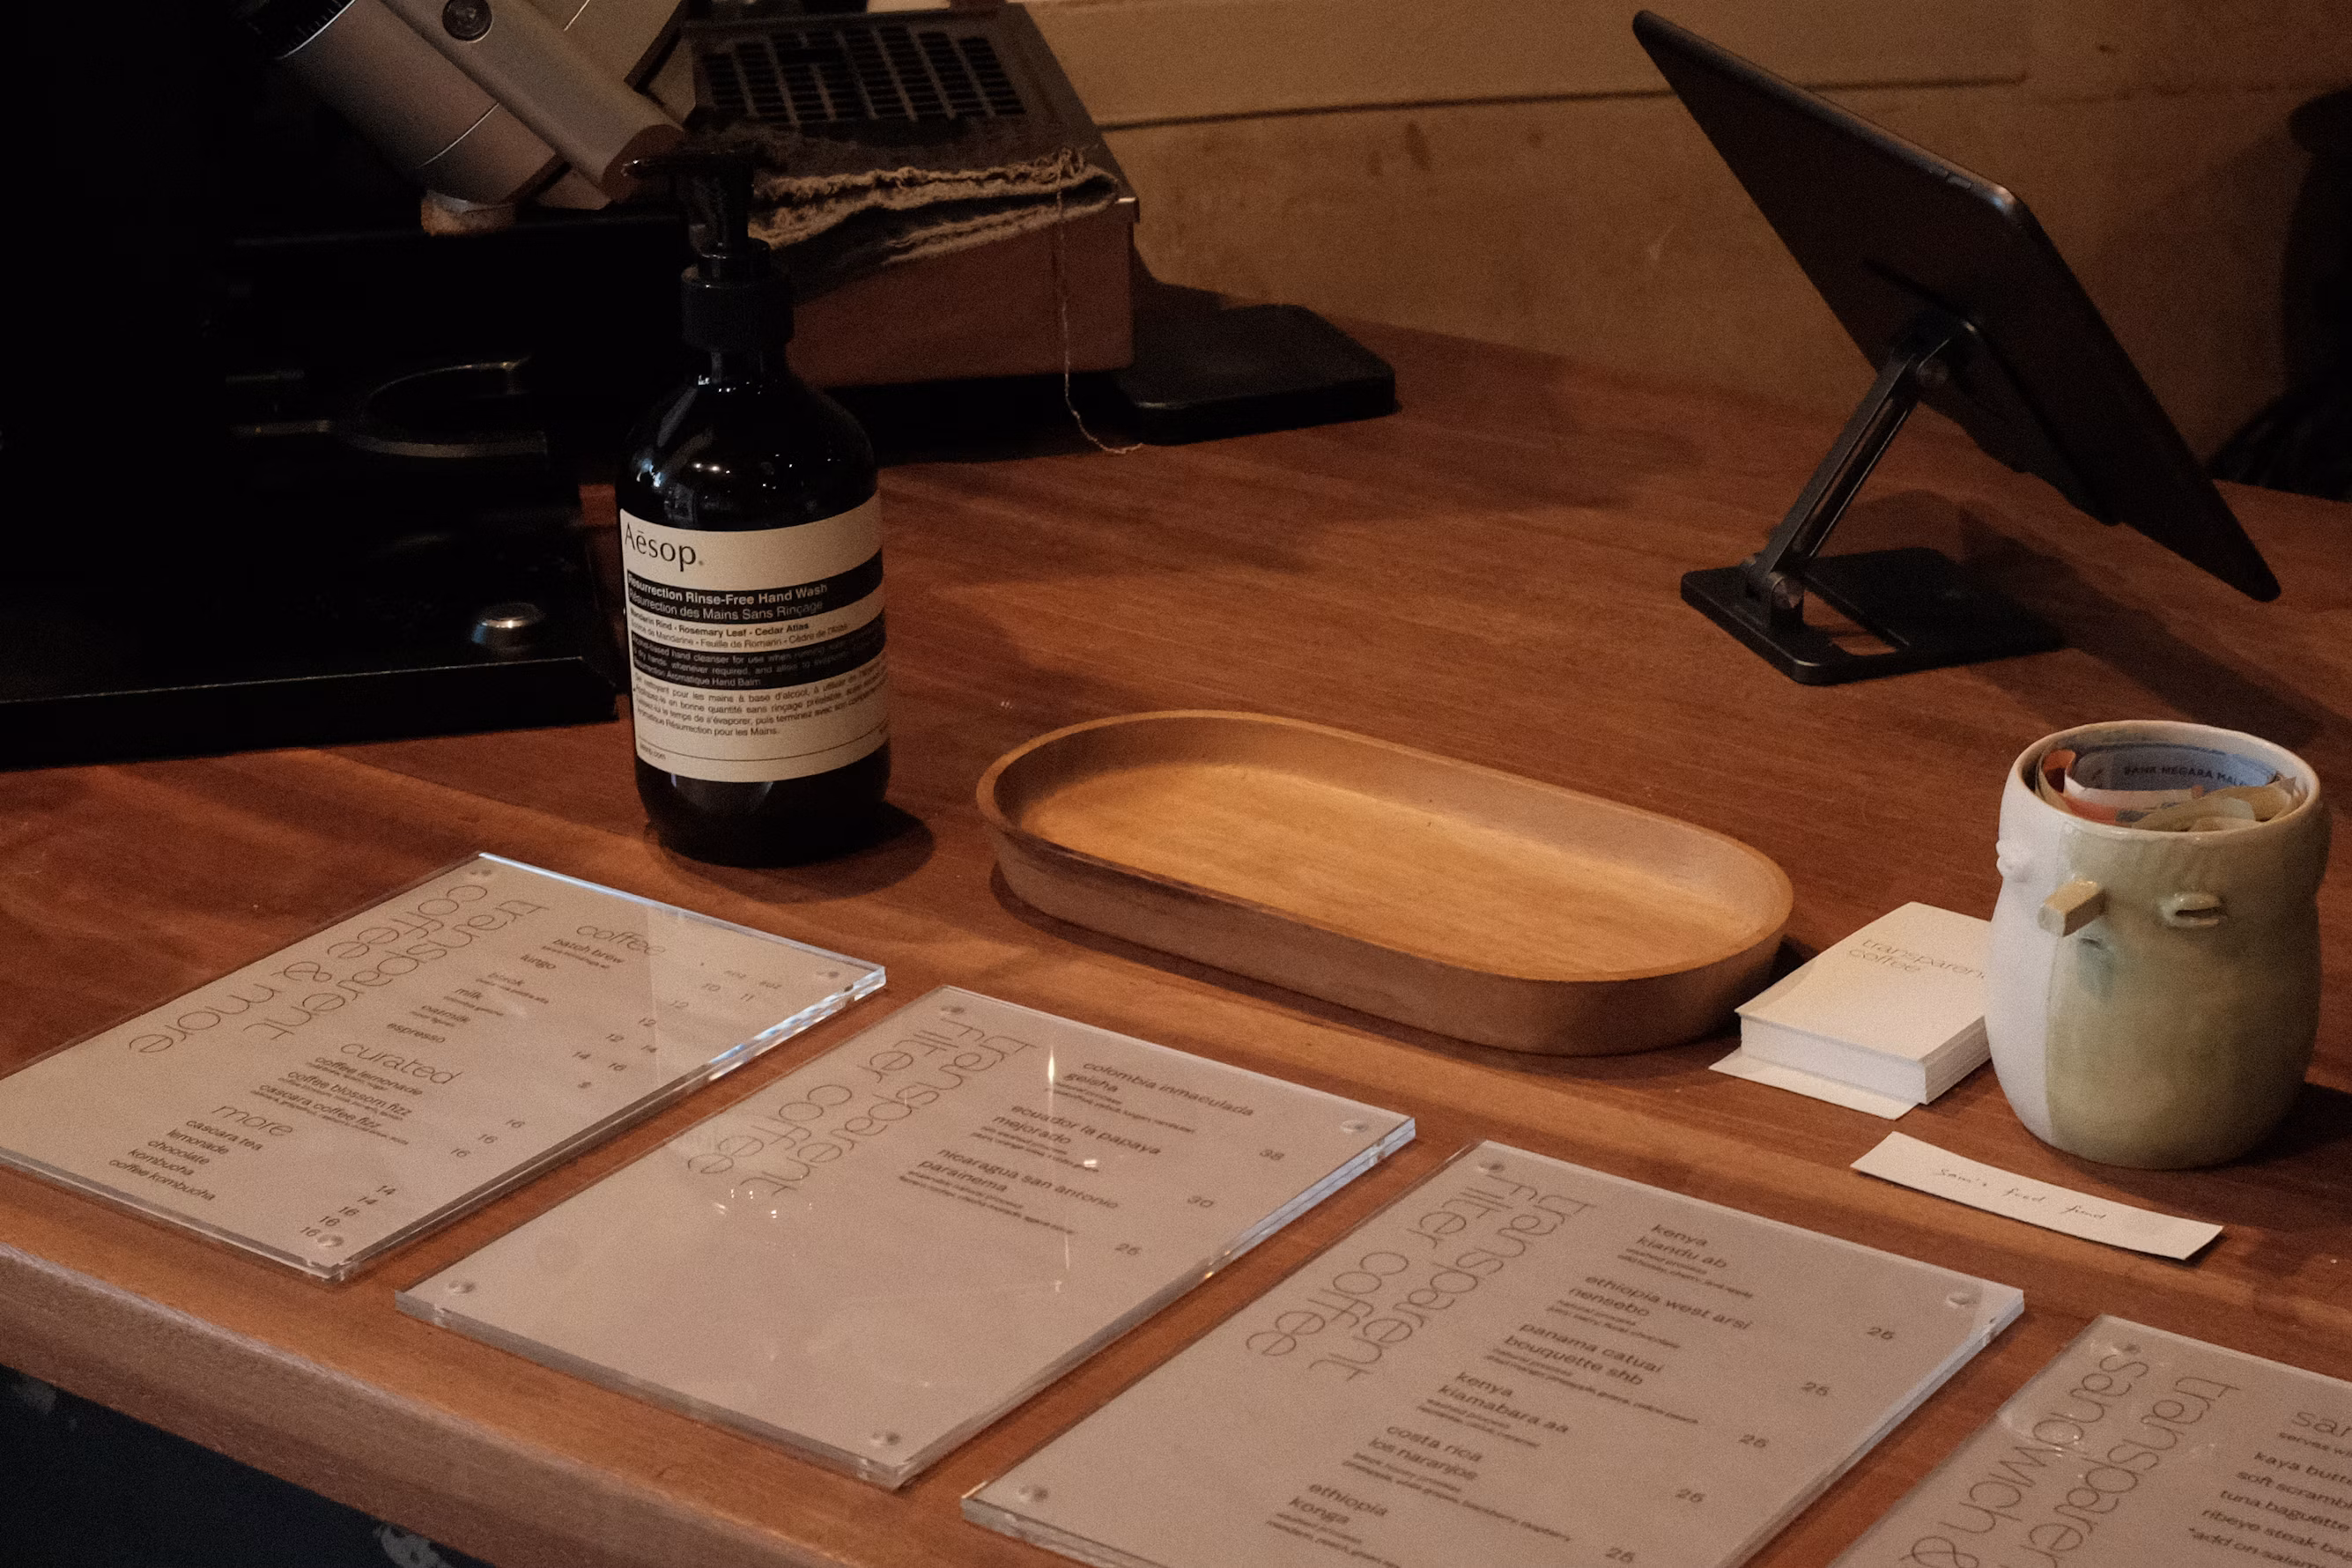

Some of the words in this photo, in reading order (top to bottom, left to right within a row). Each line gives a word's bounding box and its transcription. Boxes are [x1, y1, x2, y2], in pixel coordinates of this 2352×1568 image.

[628, 573, 683, 602] Resurrection
[685, 592, 755, 605] Rinse-Free
[758, 590, 792, 604] Hand
[795, 584, 828, 599] Wash
[680, 605, 699, 618] des
[703, 608, 739, 620] Mains
[743, 608, 773, 620] Sans
[776, 601, 823, 617] Rinçage
[679, 625, 723, 638] Rosemary
[755, 625, 783, 636] Cedar
[326, 884, 488, 958] coffee
[575, 925, 665, 955] coffee
[270, 960, 333, 982] &
[519, 954, 557, 969] lungo
[590, 949, 625, 963] brew
[1849, 949, 1920, 973] coffee
[453, 987, 483, 1000] milk
[128, 983, 282, 1053] more
[386, 1023, 446, 1043] espresso
[340, 1043, 462, 1084] curated
[858, 1018, 985, 1082] filter
[314, 1056, 357, 1074] coffee
[354, 1070, 423, 1095] lemonade
[505, 1119, 526, 1128] 16
[1062, 1072, 1118, 1091] geisha
[1082, 1062, 1157, 1089] colombia
[1158, 1084, 1254, 1115] inmaculada
[211, 1106, 294, 1136] more
[258, 1084, 312, 1106] cascara
[307, 1103, 355, 1121] coffee
[355, 1117, 381, 1128] fizz
[449, 1147, 470, 1158] 16
[287, 1071, 329, 1088] coffee
[329, 1084, 387, 1107] blossom
[386, 1103, 412, 1116] fizz
[477, 1133, 499, 1143] 16
[686, 1084, 853, 1173] coffee
[1010, 1105, 1080, 1128] ecuador
[1079, 1124, 1098, 1135] la
[1096, 1132, 1161, 1155] papaya
[166, 1128, 229, 1154] lemonade
[356, 1195, 379, 1205] 14
[185, 1120, 239, 1141] cascara
[237, 1137, 263, 1150] tea
[375, 1184, 397, 1195] 14
[917, 1160, 1007, 1192] parainema
[992, 1116, 1071, 1143] mejorado
[1186, 1194, 1216, 1208] 30
[107, 1159, 150, 1176] coffee
[147, 1172, 216, 1201] kombucha
[299, 1226, 322, 1237] 16
[127, 1148, 195, 1175] kombucha
[318, 1215, 341, 1227] 16
[146, 1140, 211, 1165] chocolate
[337, 1206, 360, 1217] 16
[937, 1149, 1019, 1179] nicaragua
[1020, 1174, 1053, 1188] san
[1054, 1185, 1119, 1209] antonio
[1408, 1174, 1537, 1248] filter
[1635, 1236, 1698, 1259] kiandu
[1701, 1256, 1727, 1268] ab
[1650, 1224, 1708, 1246] kenya
[1246, 1251, 1409, 1356] coffee
[1568, 1287, 1649, 1316] nensebo
[1584, 1276, 1660, 1303] ethiopia
[1664, 1300, 1711, 1318] west
[1712, 1313, 1753, 1329] arsi
[1503, 1335, 1602, 1372] bouquette
[1605, 1368, 1644, 1385] shb
[1518, 1323, 1598, 1351] panama
[1601, 1349, 1664, 1372] catuai
[1454, 1371, 1513, 1397] kenya
[1437, 1385, 1541, 1424] kiamabara
[1542, 1421, 1570, 1434] aa
[1367, 1437, 1395, 1453] los
[1396, 1449, 1478, 1480] naranjos
[1386, 1426, 1440, 1448] costa
[1444, 1445, 1483, 1462] rica
[1939, 1354, 2149, 1534] sandwich
[2253, 1451, 2300, 1471] kaya
[2278, 1431, 2329, 1451] serves
[1307, 1483, 1388, 1517] ethiopia
[2237, 1471, 2273, 1488] soft
[1288, 1496, 1350, 1524] konga
[2201, 1509, 2261, 1531] ribeye
[2264, 1527, 2318, 1549] steak
[2220, 1490, 2261, 1508] tuna
[2265, 1500, 2350, 1532] baguette
[2233, 1542, 2260, 1554] on
